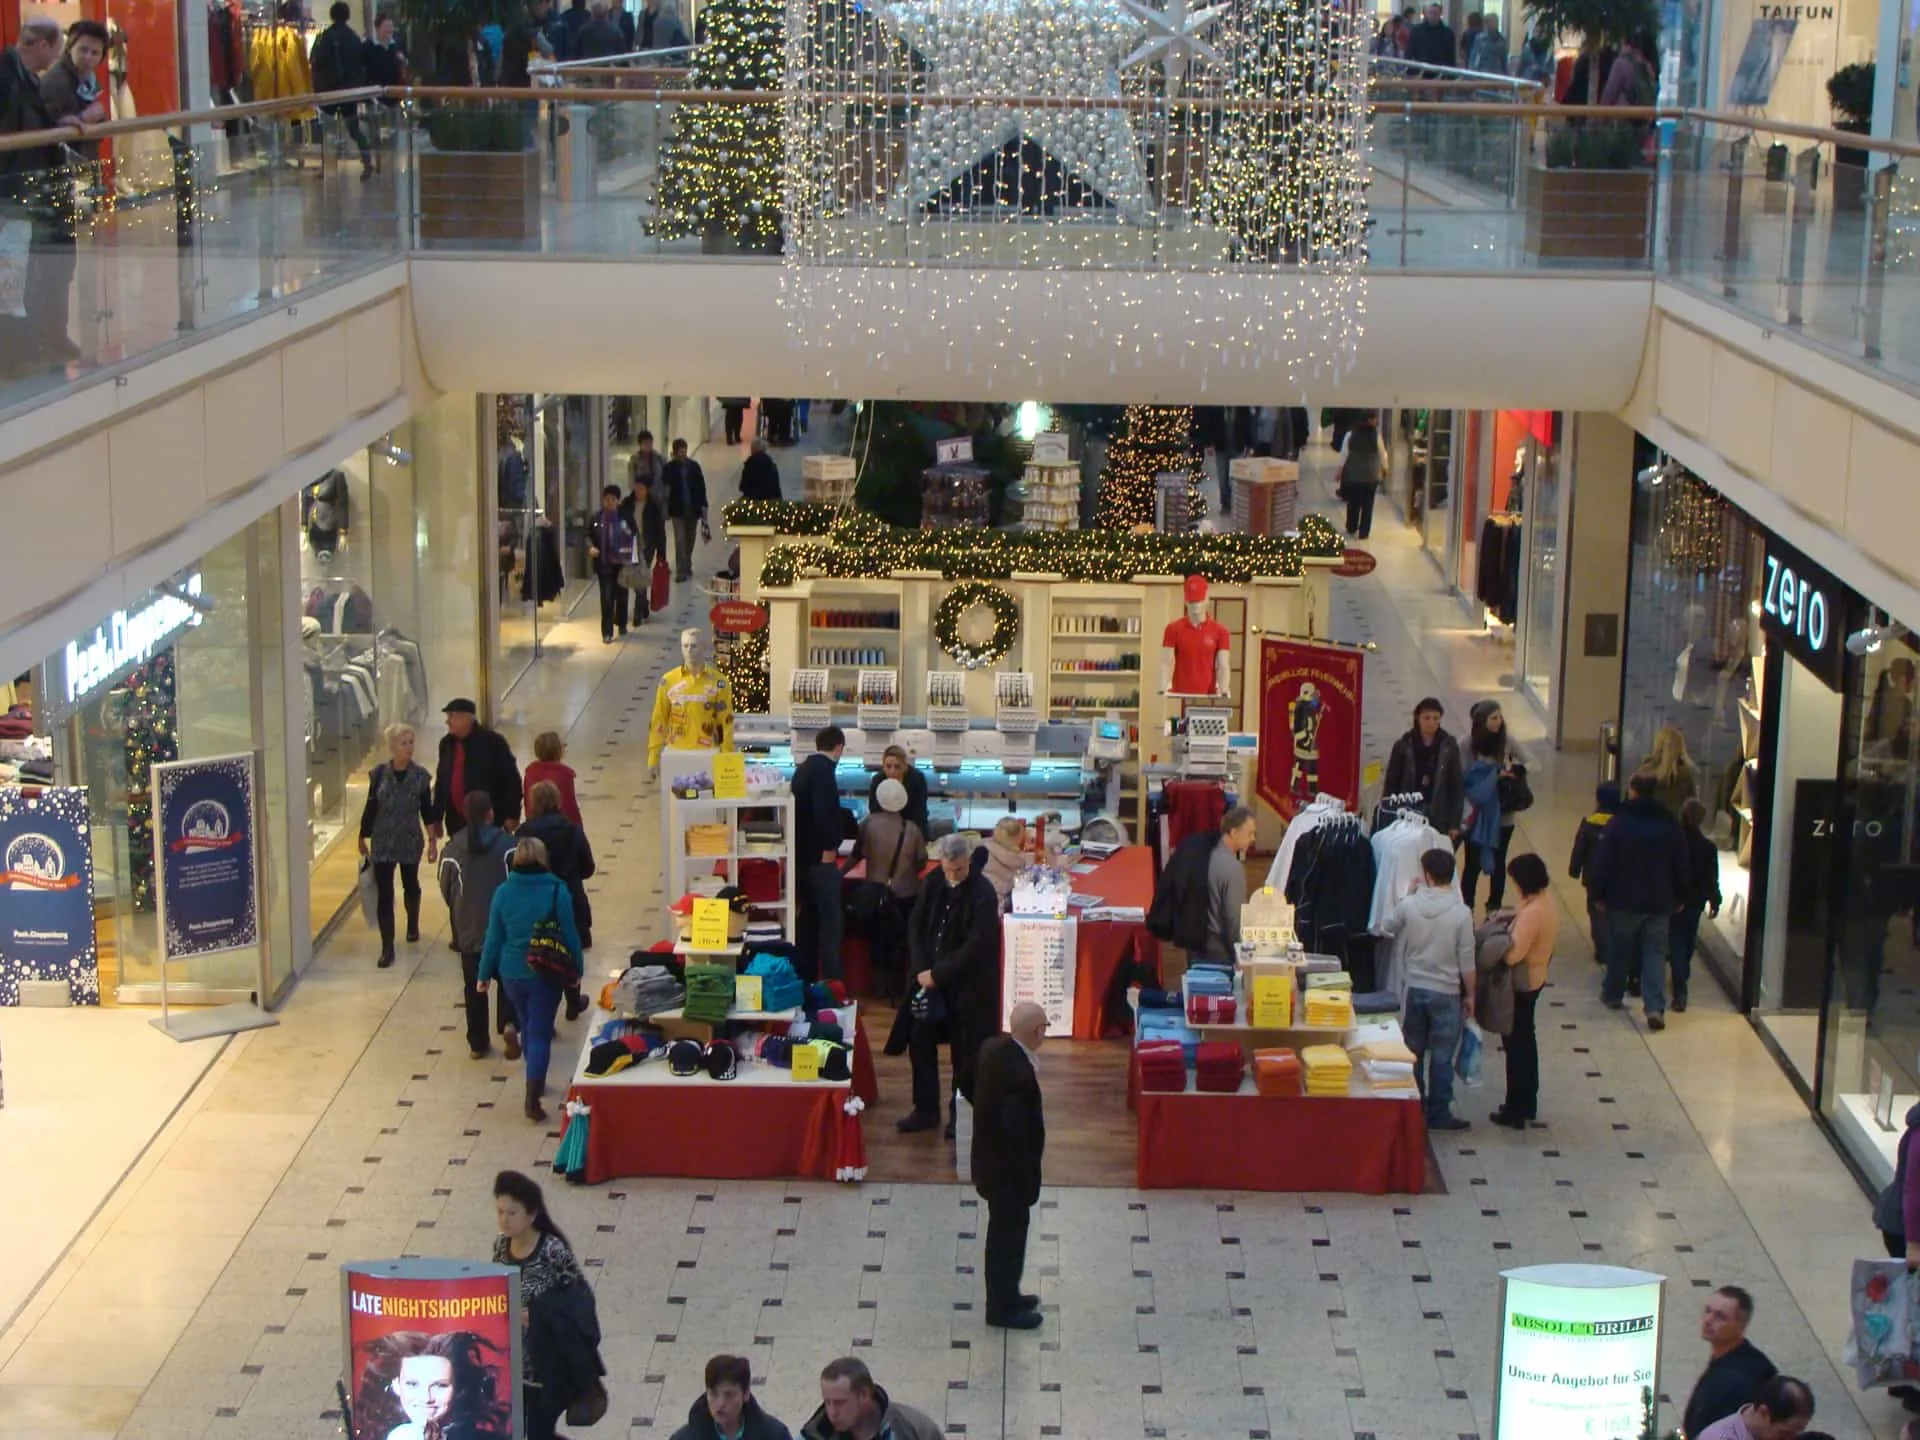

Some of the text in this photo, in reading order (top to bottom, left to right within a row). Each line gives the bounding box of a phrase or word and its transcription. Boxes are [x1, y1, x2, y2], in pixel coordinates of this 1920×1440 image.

[1760, 5, 1833, 20] TAIFUN
[1764, 555, 1828, 650] zero
[1508, 1364, 1547, 1383] Unser
[1552, 1373, 1609, 1389] Angebot
[1633, 1369, 1652, 1382] Sie
